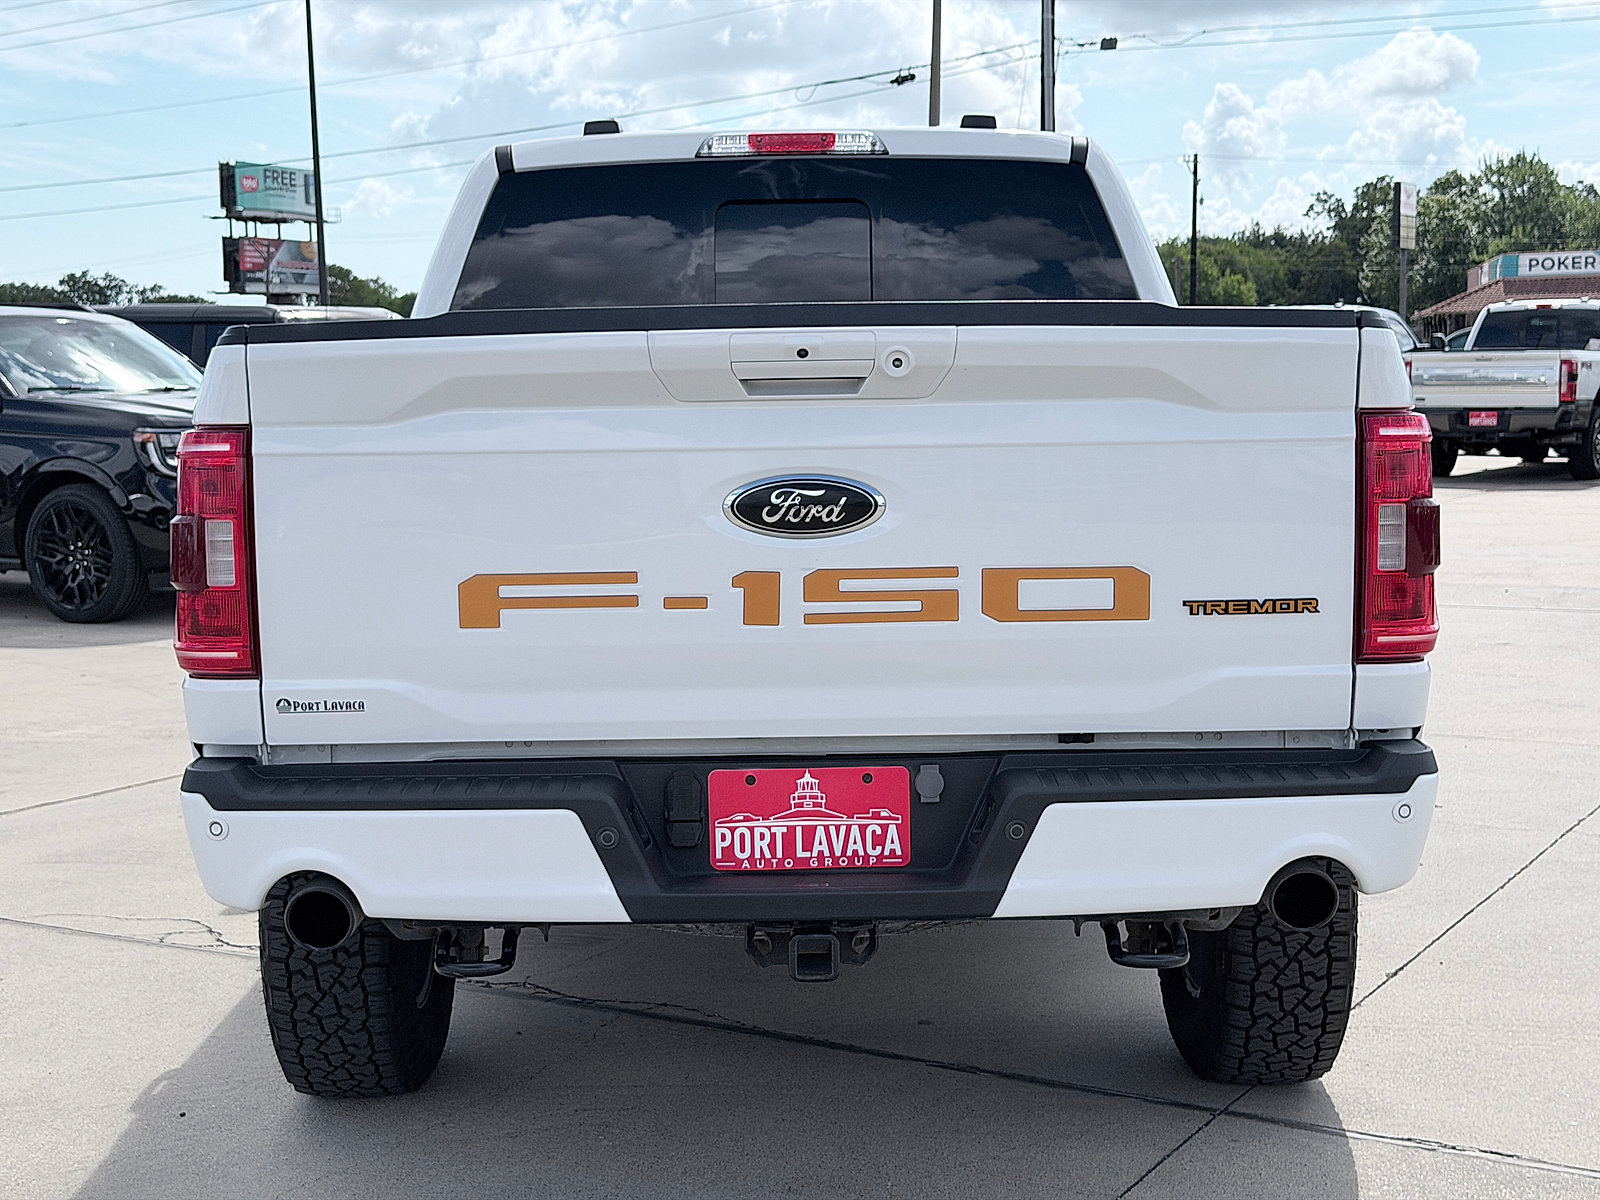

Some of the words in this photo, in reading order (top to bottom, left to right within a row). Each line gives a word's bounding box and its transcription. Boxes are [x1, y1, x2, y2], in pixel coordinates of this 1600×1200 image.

[263, 169, 297, 187] FREE
[1528, 255, 1597, 272] POKER
[761, 487, 848, 523] Ford
[458, 566, 1151, 629] F-150
[1182, 597, 1321, 616] TREMOR
[292, 700, 321, 712] PORT
[323, 699, 366, 711] LAVACA
[715, 826, 788, 859] PORT
[796, 824, 903, 858] LAVACA
[741, 858, 794, 869] AUTO
[809, 856, 878, 867] GROUP
